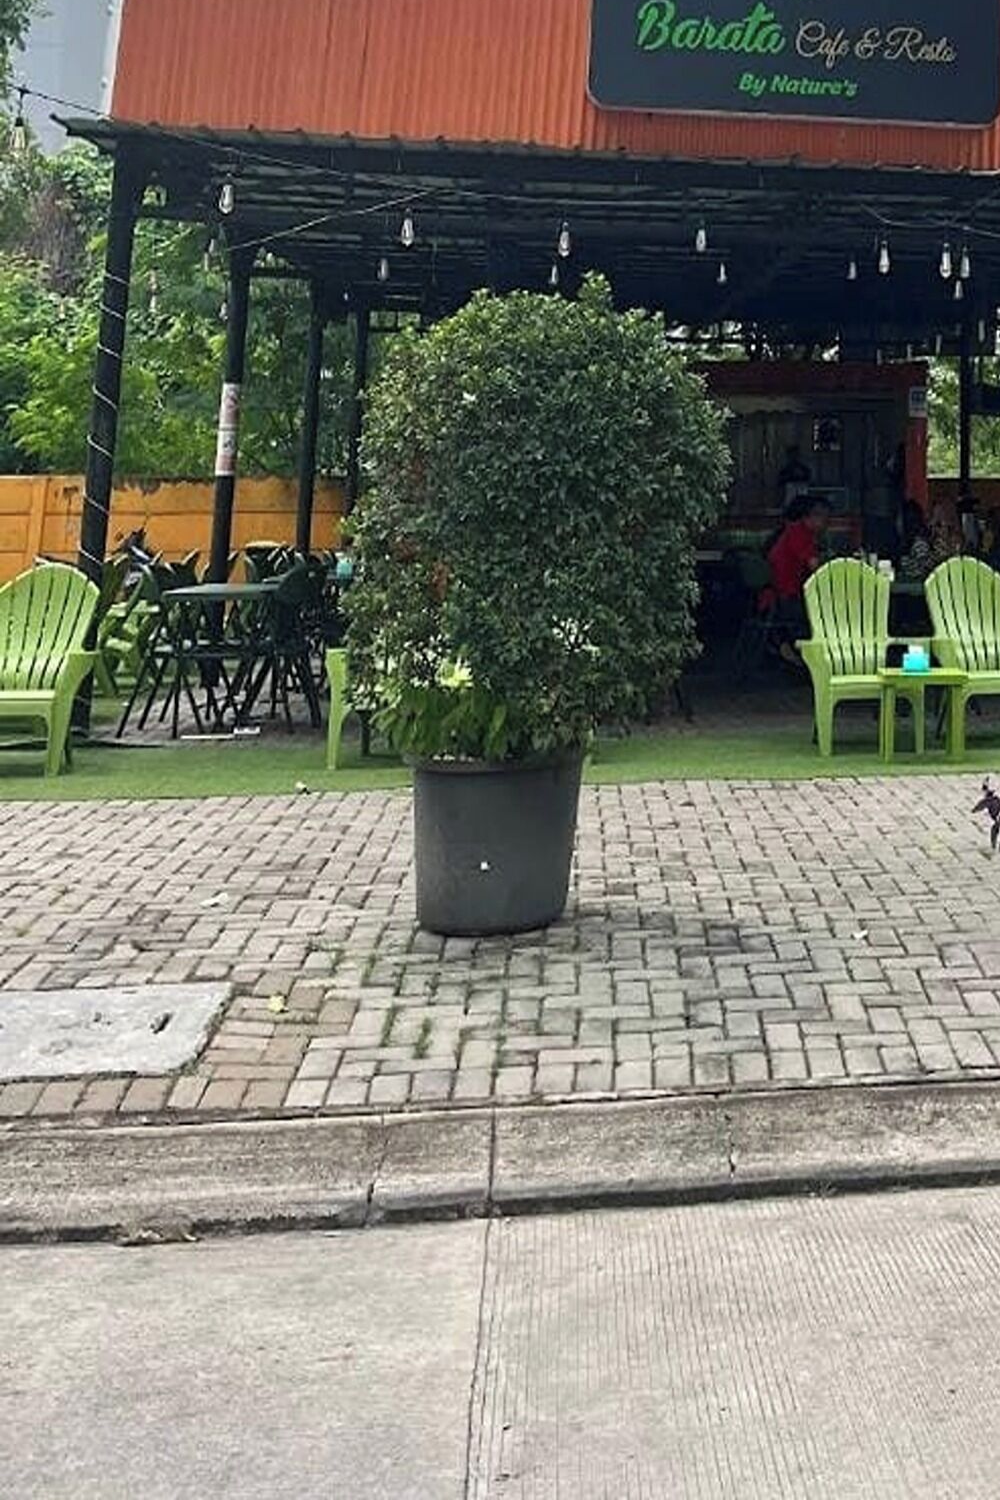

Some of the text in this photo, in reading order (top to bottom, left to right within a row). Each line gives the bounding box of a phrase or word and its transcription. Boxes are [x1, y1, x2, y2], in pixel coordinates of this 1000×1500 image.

[795, 21, 850, 69] Cafe
[855, 28, 882, 57] &
[885, 26, 957, 63] Resto
[738, 73, 766, 97] By
